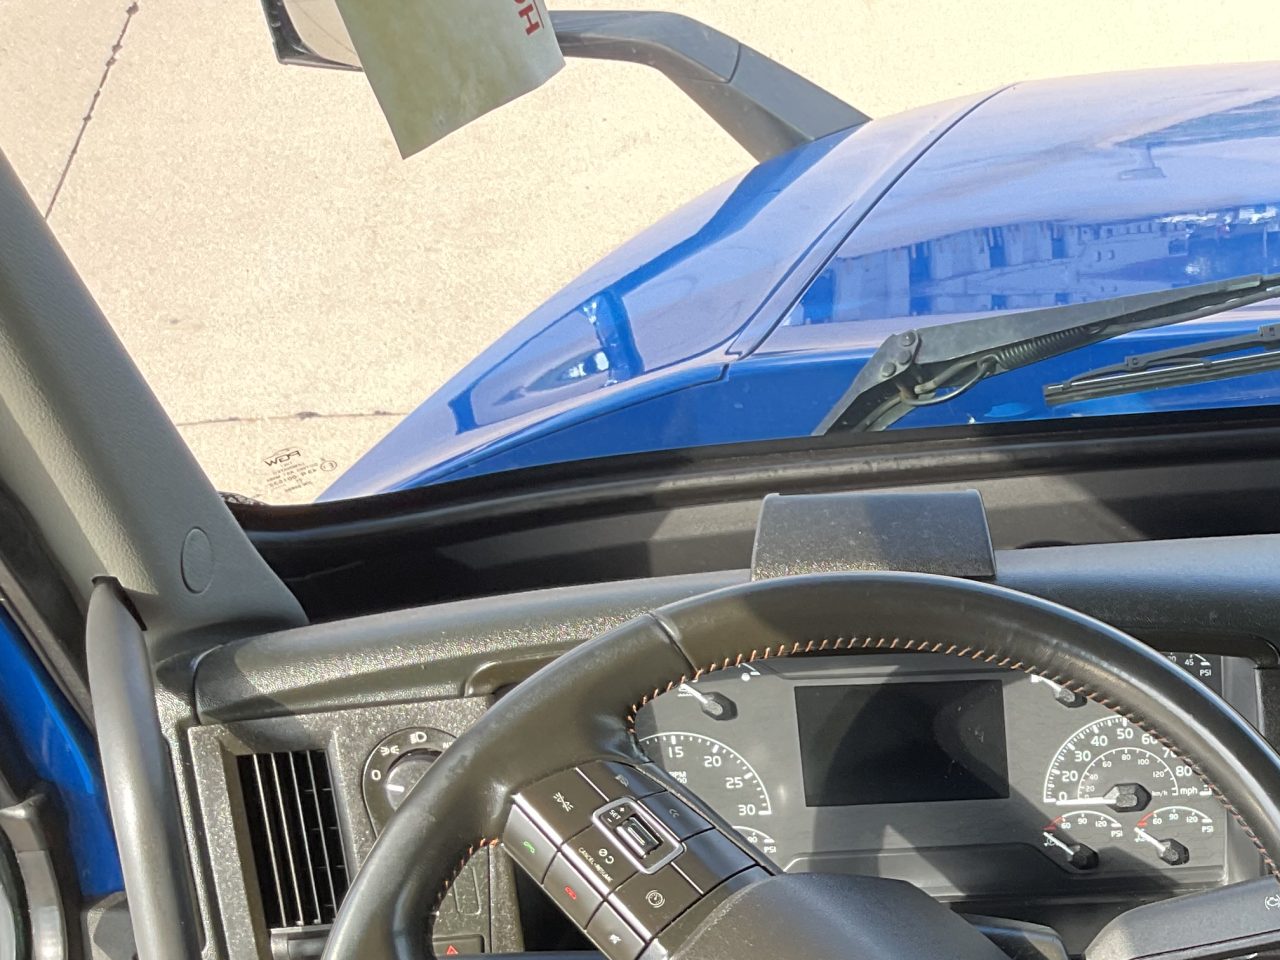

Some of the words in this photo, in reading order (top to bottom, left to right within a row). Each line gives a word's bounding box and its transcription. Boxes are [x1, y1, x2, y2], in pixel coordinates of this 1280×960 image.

[1184, 658, 1195, 666] 45
[1199, 669, 1212, 677] PSI
[1116, 728, 1134, 739] 50
[1091, 735, 1108, 746] 40
[668, 746, 684, 758] 15
[1074, 750, 1091, 762] 30
[703, 756, 722, 767] 20
[1137, 758, 1150, 766] 100
[1062, 770, 1078, 782] 20
[1175, 765, 1193, 777] 80
[1089, 773, 1099, 781] 40
[725, 777, 743, 789] 25
[1180, 786, 1198, 796] mph
[608, 809, 622, 820] SET
[738, 804, 756, 816] 30
[1077, 817, 1088, 825] 90
[1095, 820, 1108, 828] 120
[1185, 815, 1198, 823] 120
[1111, 830, 1123, 838] PSI
[1202, 825, 1214, 833] PSI
